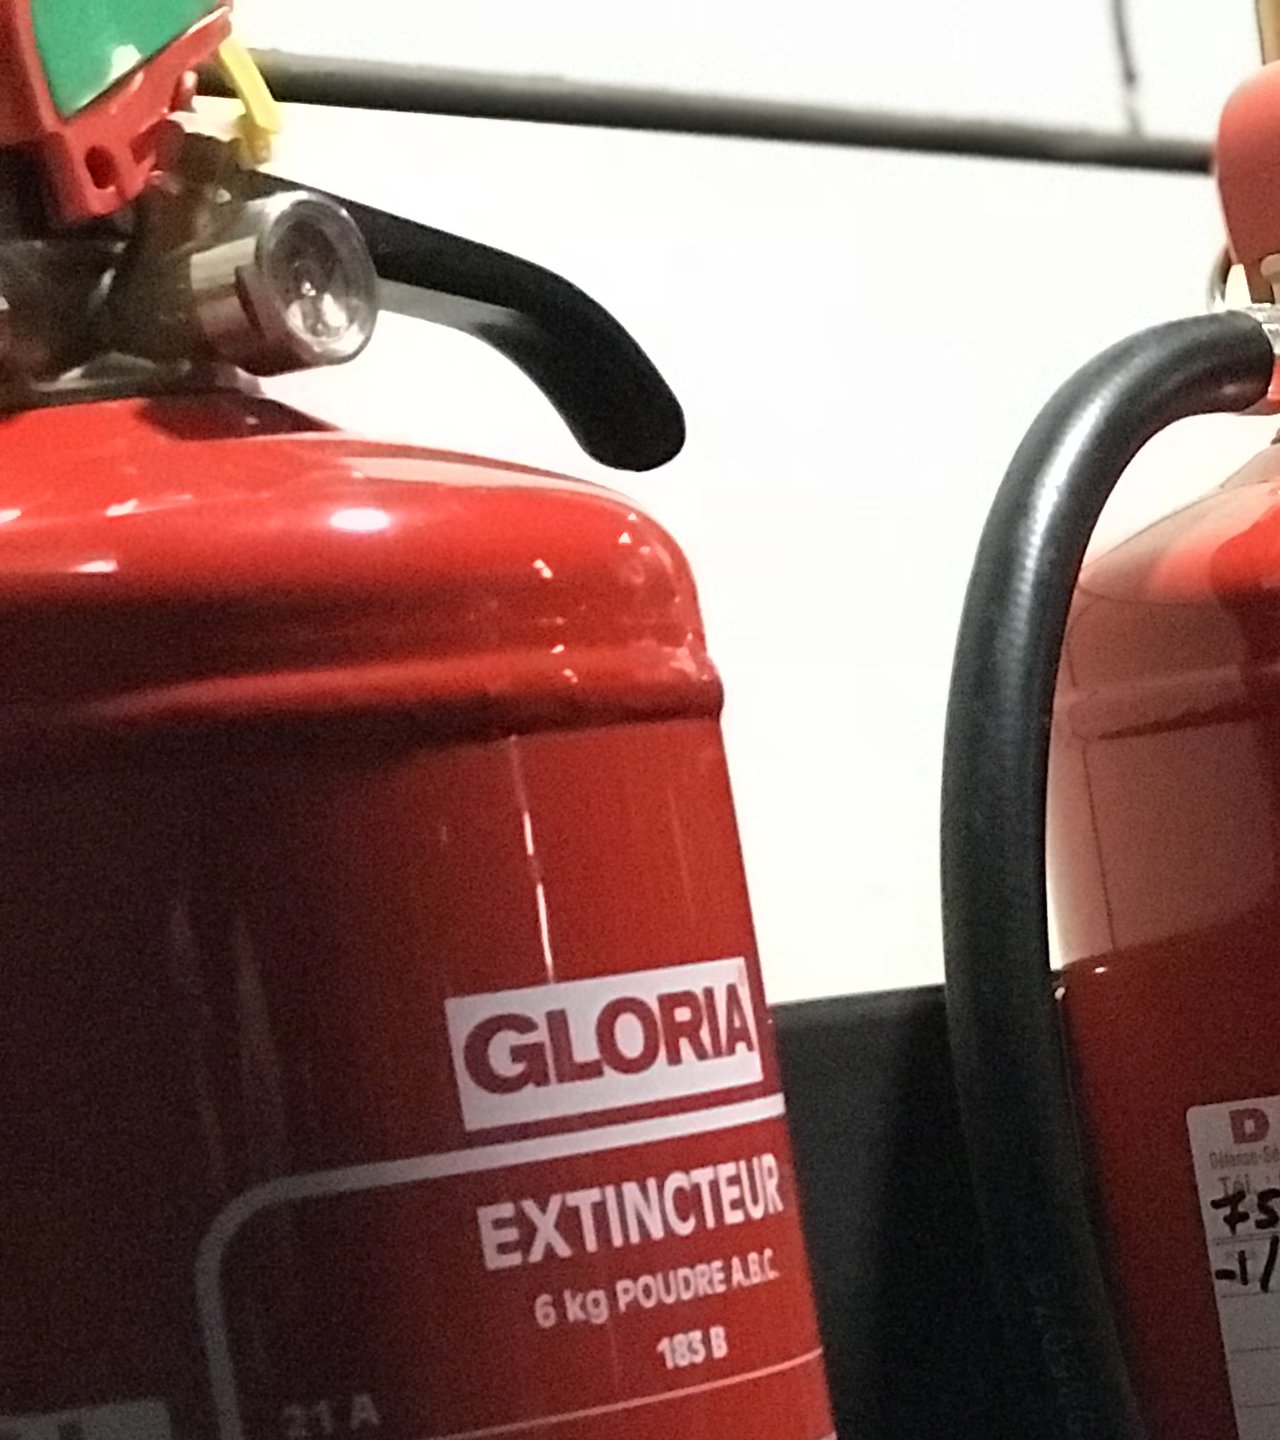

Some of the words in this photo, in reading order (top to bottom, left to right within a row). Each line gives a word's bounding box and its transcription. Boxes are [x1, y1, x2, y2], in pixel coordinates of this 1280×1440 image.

[464, 983, 755, 1095] GLORIA
[477, 1153, 783, 1271] EXTINCTEUR
[536, 1294, 556, 1328] 6
[567, 1288, 607, 1325] kg
[617, 1263, 726, 1313] POUDRE
[657, 1330, 705, 1370] 183
[709, 1326, 727, 1359] B
[351, 1394, 380, 1429] A
